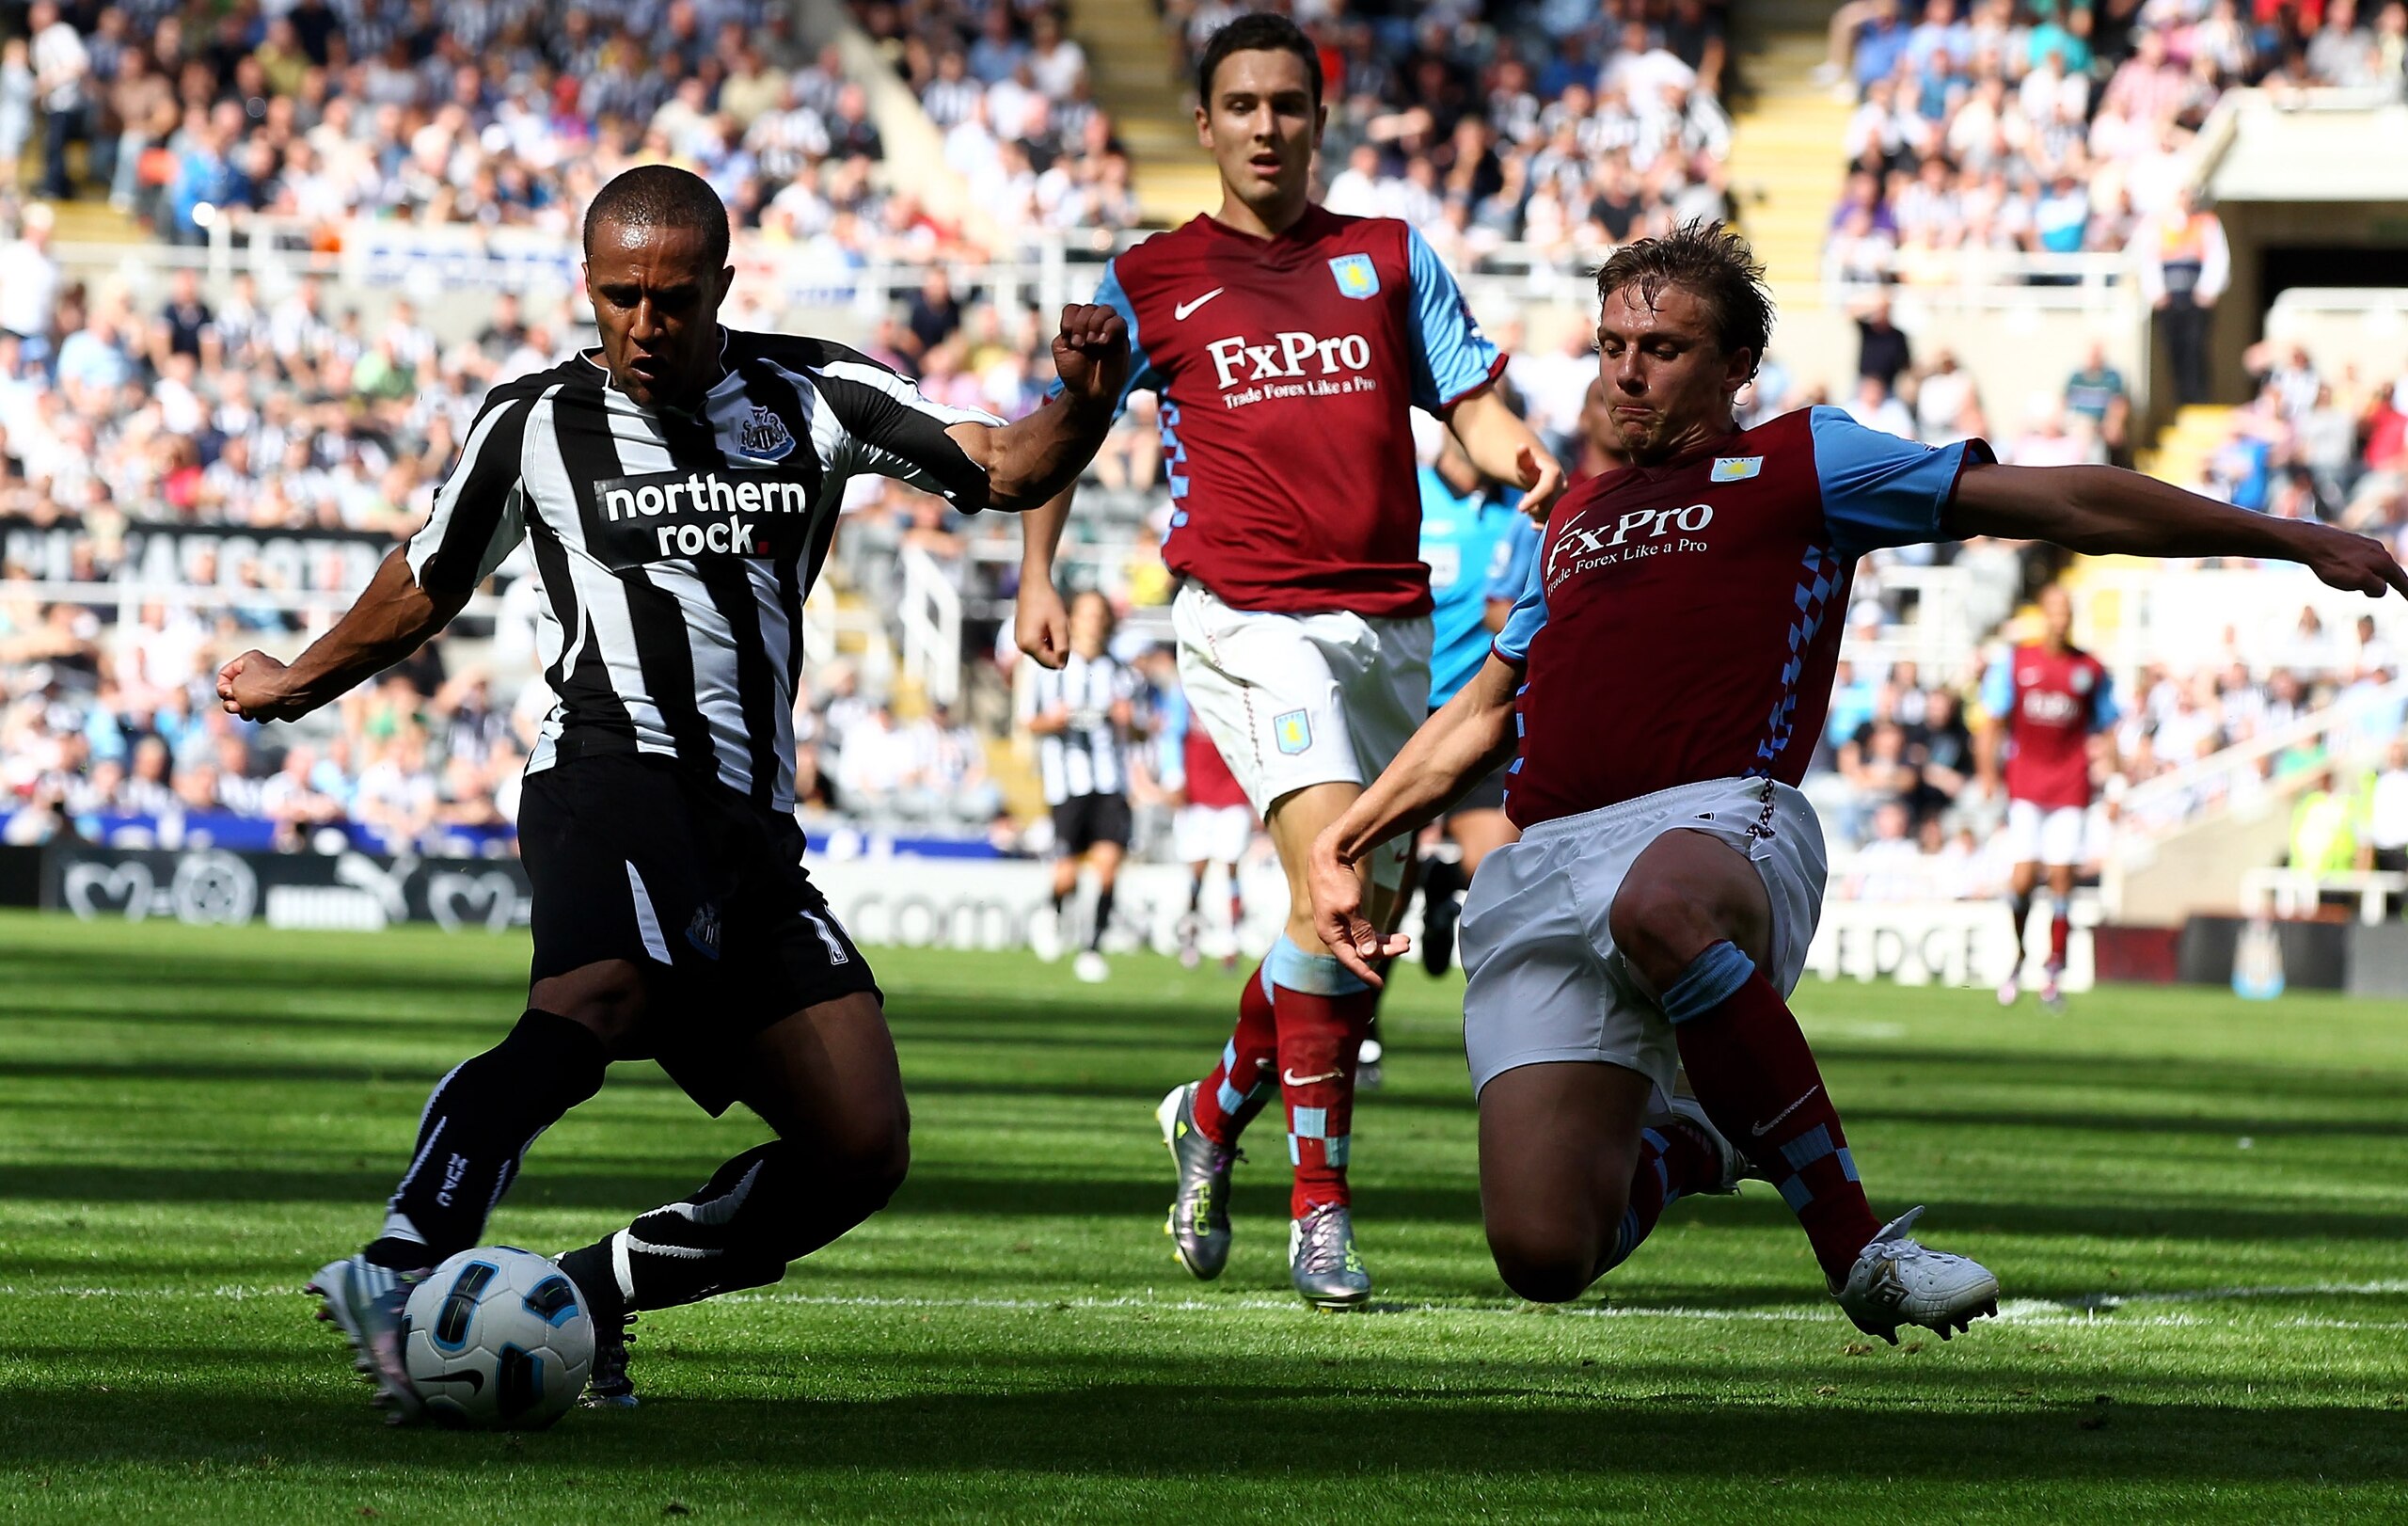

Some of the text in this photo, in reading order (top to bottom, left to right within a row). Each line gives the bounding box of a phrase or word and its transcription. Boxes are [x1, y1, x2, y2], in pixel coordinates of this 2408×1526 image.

[1205, 331, 1370, 390] FxPro
[1222, 375, 1377, 410] Trade Forex Like a Pro
[605, 472, 806, 522] northern
[1546, 503, 1714, 580] FxPro
[1575, 552, 1618, 575] Forex
[1624, 544, 1658, 562] Like
[1662, 542, 1671, 553] a
[1677, 538, 1708, 552] Pro
